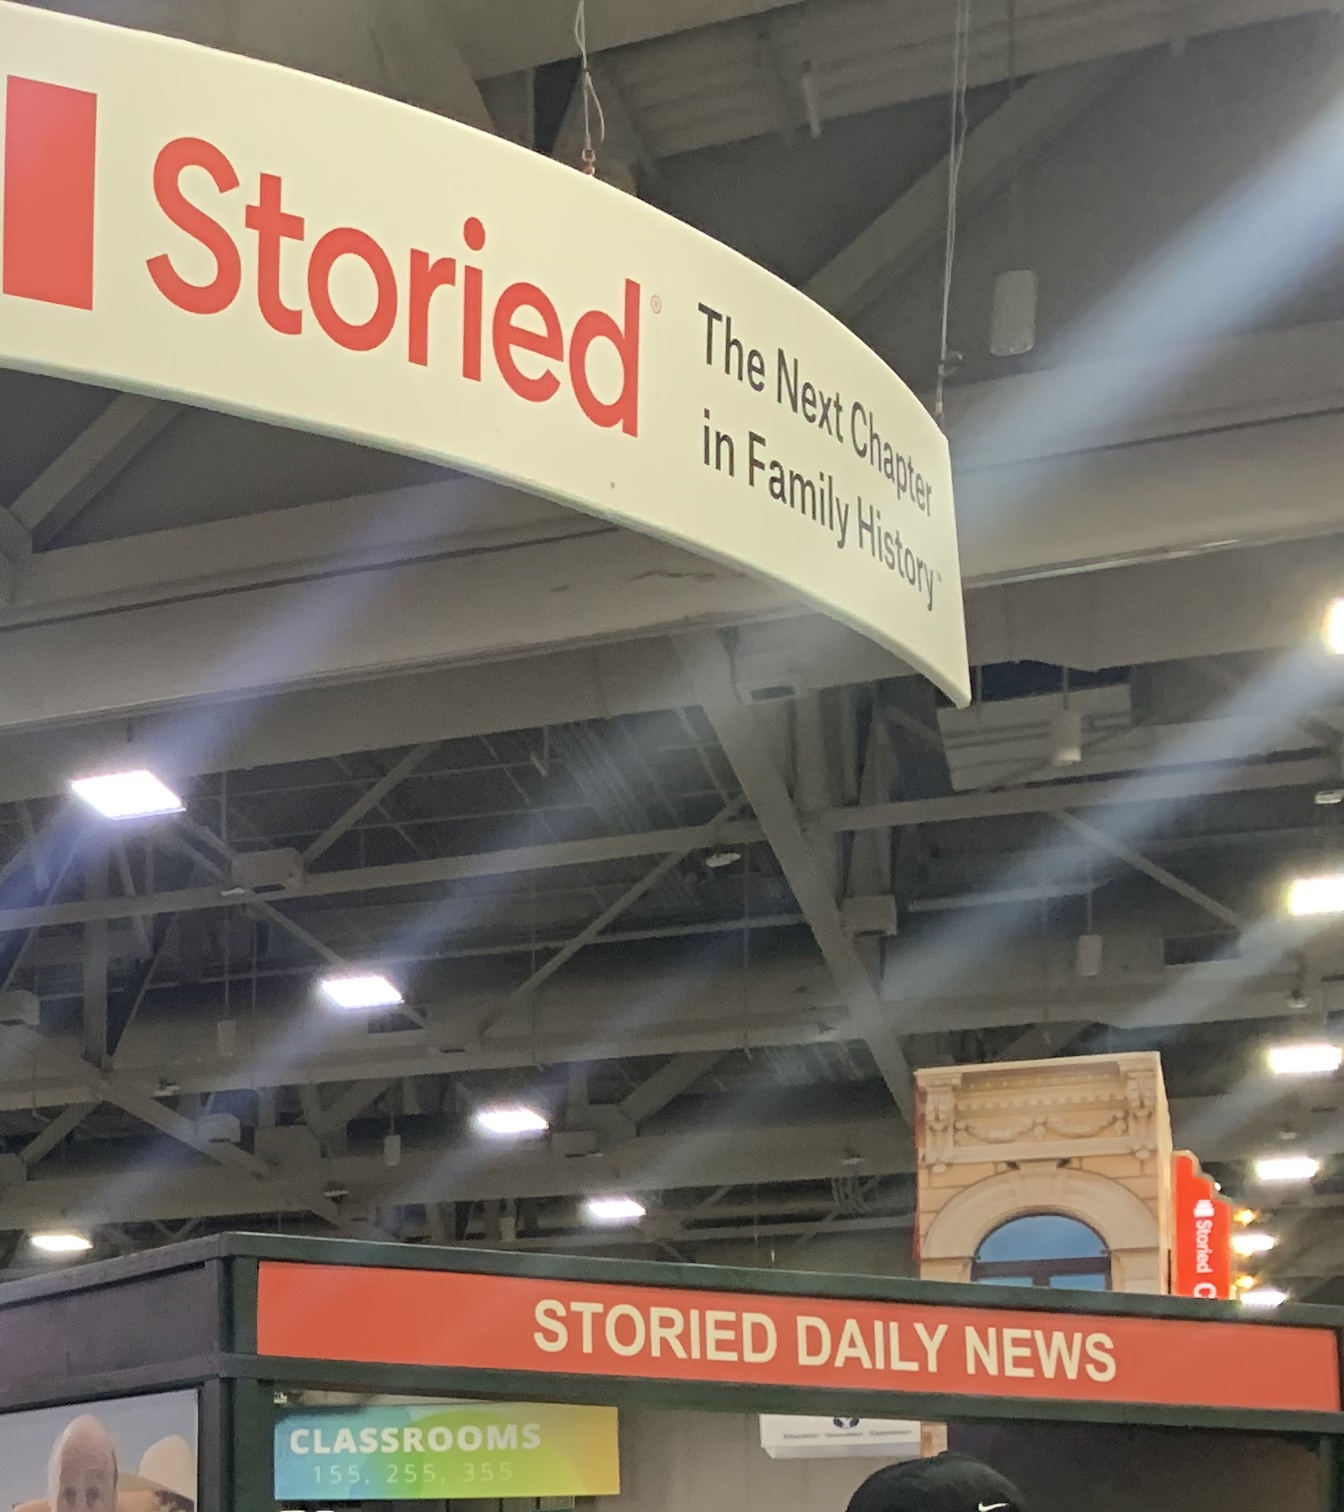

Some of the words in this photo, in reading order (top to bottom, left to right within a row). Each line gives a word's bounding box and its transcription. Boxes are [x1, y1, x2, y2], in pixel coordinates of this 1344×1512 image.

[145, 136, 641, 438] Storied
[698, 302, 765, 391] The
[776, 347, 844, 443] Next
[850, 401, 933, 517] Chapter
[703, 407, 735, 477] in
[748, 430, 849, 549] Family
[1195, 1219, 1214, 1274] Storied
[533, 1299, 778, 1363] STORIED
[797, 1315, 948, 1373] DAILY
[965, 1326, 1117, 1383] NEWS
[289, 1423, 542, 1455] CLASSROOMS
[313, 1464, 371, 1486] 155,
[386, 1462, 446, 1485] 255,
[463, 1460, 513, 1483] 355
